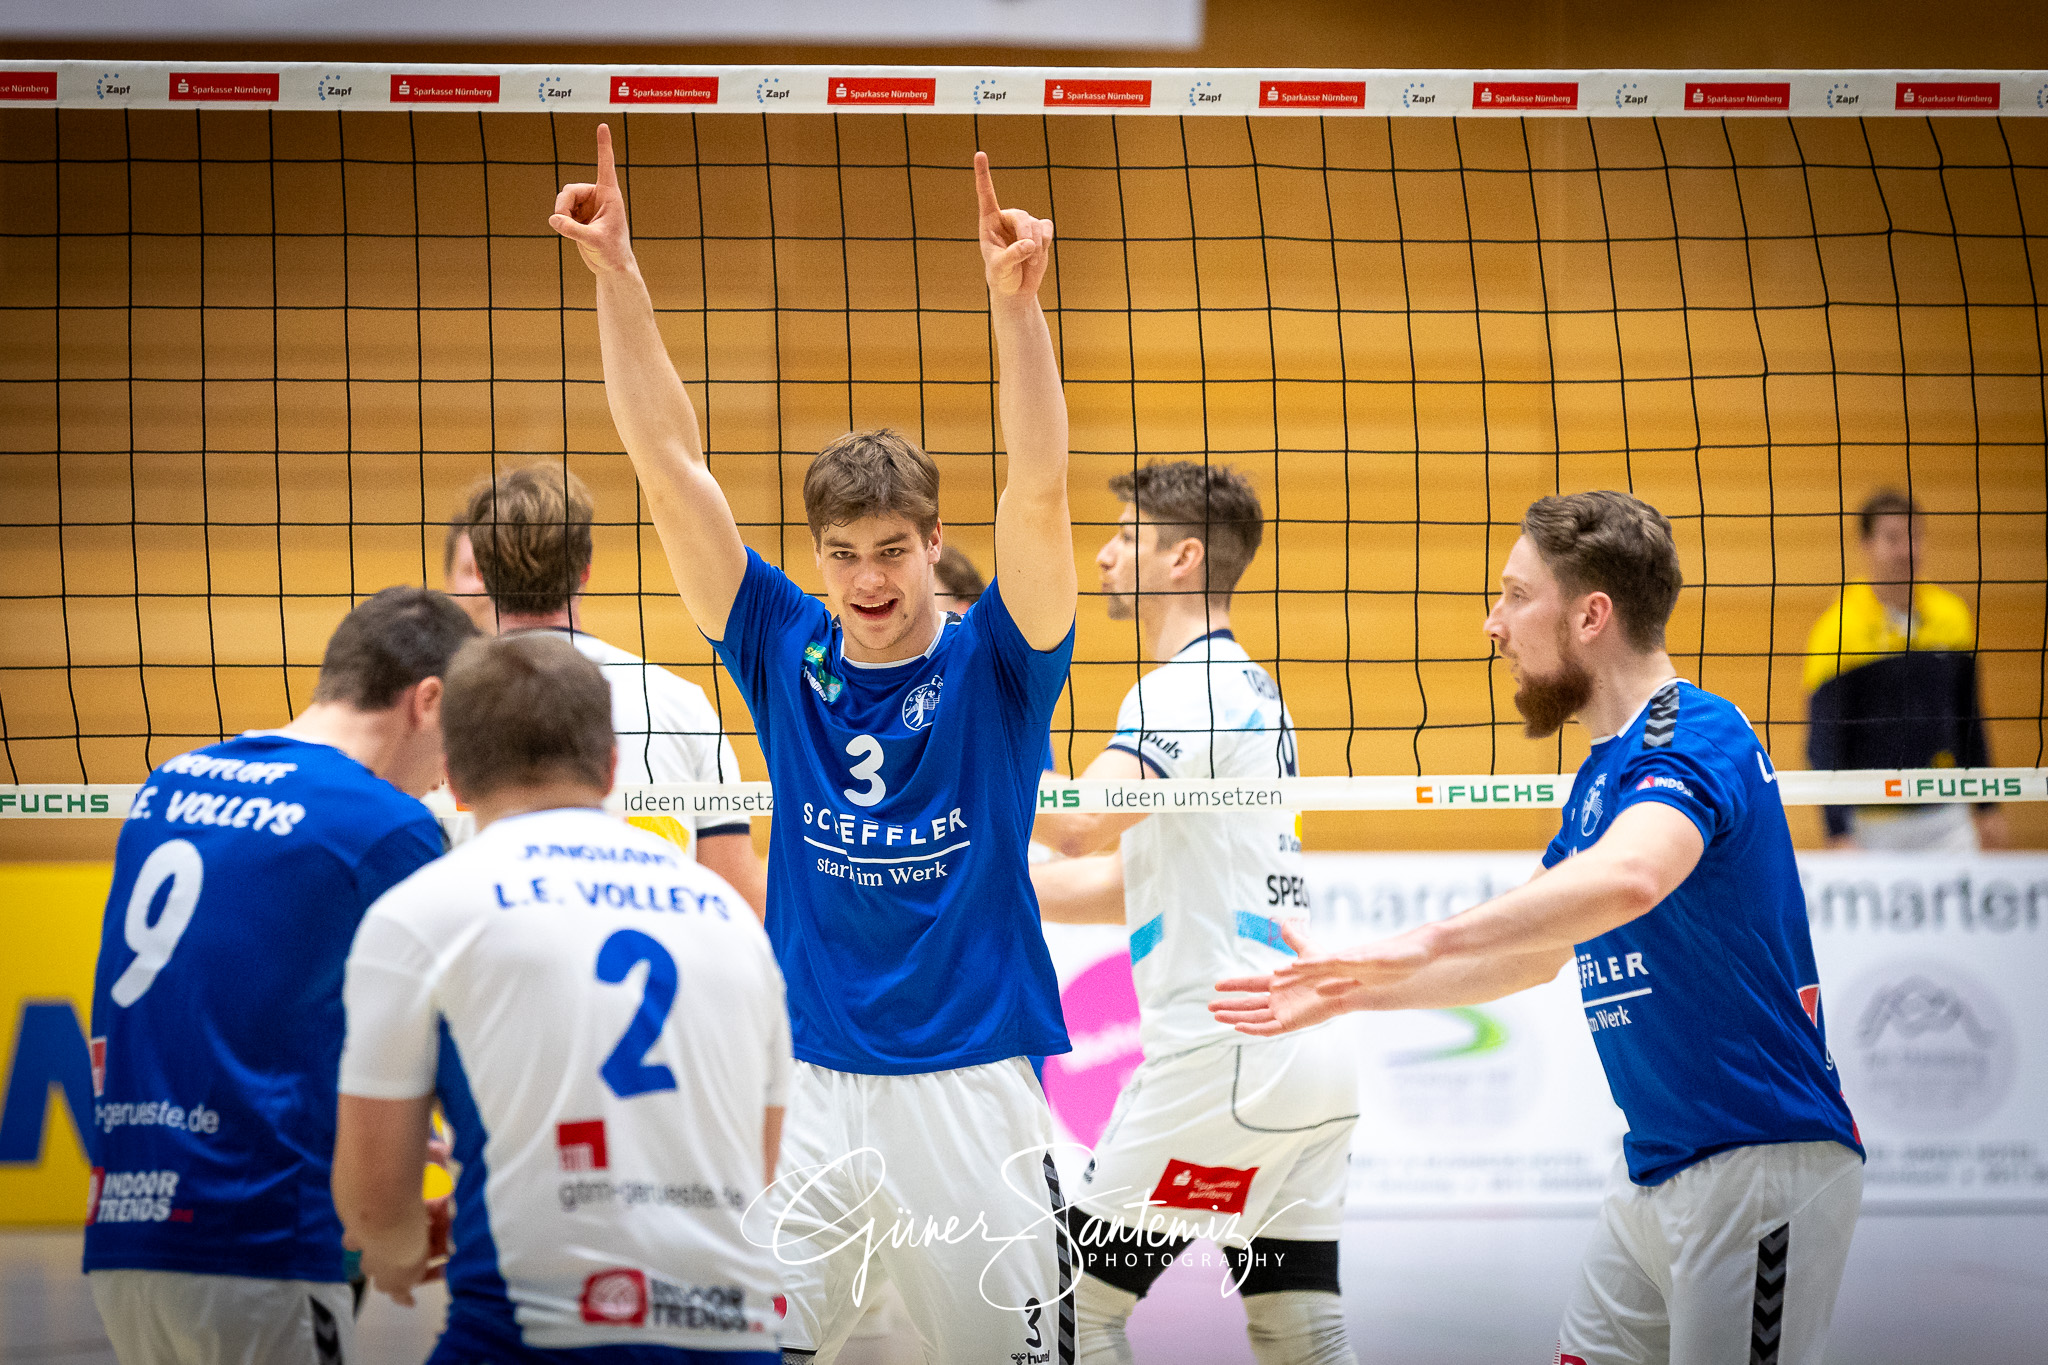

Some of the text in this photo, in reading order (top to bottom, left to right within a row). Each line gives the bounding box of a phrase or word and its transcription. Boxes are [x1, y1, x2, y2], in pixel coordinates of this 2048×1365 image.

[11, 84, 50, 95] Nürnberg
[106, 84, 131, 97] Zapf
[193, 85, 271, 95] Sparkasse Nürnberg
[327, 85, 352, 98] Zapf
[413, 86, 492, 97] Sparkasse Nürnberg
[547, 88, 572, 100] Zapf
[633, 88, 712, 98] Sparkasse Nürnberg
[766, 89, 790, 101] Zapf
[850, 89, 929, 100] Sparkasse Nürnberg
[982, 91, 1007, 102] Zapf
[1067, 91, 1144, 101] Sparkasse Nürnberg
[1198, 92, 1222, 104] Zapf
[1281, 92, 1359, 103] Sparkasse Nürnberg
[1412, 93, 1436, 105] Zapf
[1495, 94, 1572, 104] Sparkasse Nürnberg
[1624, 94, 1648, 105] Zapf
[1705, 94, 1783, 105] Sparkasse Nürnberg
[1836, 94, 1859, 105] Zapf
[1916, 94, 1994, 104] Sparkasse Nürnberg
[843, 734, 887, 807] 3
[1448, 784, 1554, 803] FUCHS
[1916, 778, 2022, 797] FUCHS
[624, 791, 774, 811] Ideen umsetz
[1105, 787, 1283, 807] Ideen umsetzen
[0, 794, 109, 813] FUCHS
[165, 789, 306, 836] VOLLEYS
[856, 867, 884, 887] im
[888, 860, 948, 885] Werk
[576, 880, 730, 921] VOLLEYS
[111, 838, 204, 1008] 9
[594, 927, 679, 1100] 2
[1596, 1005, 1632, 1029] Werk
[103, 1170, 180, 1198] INDOOR
[97, 1197, 172, 1222] TRENDS
[1024, 1297, 1042, 1348] 3
